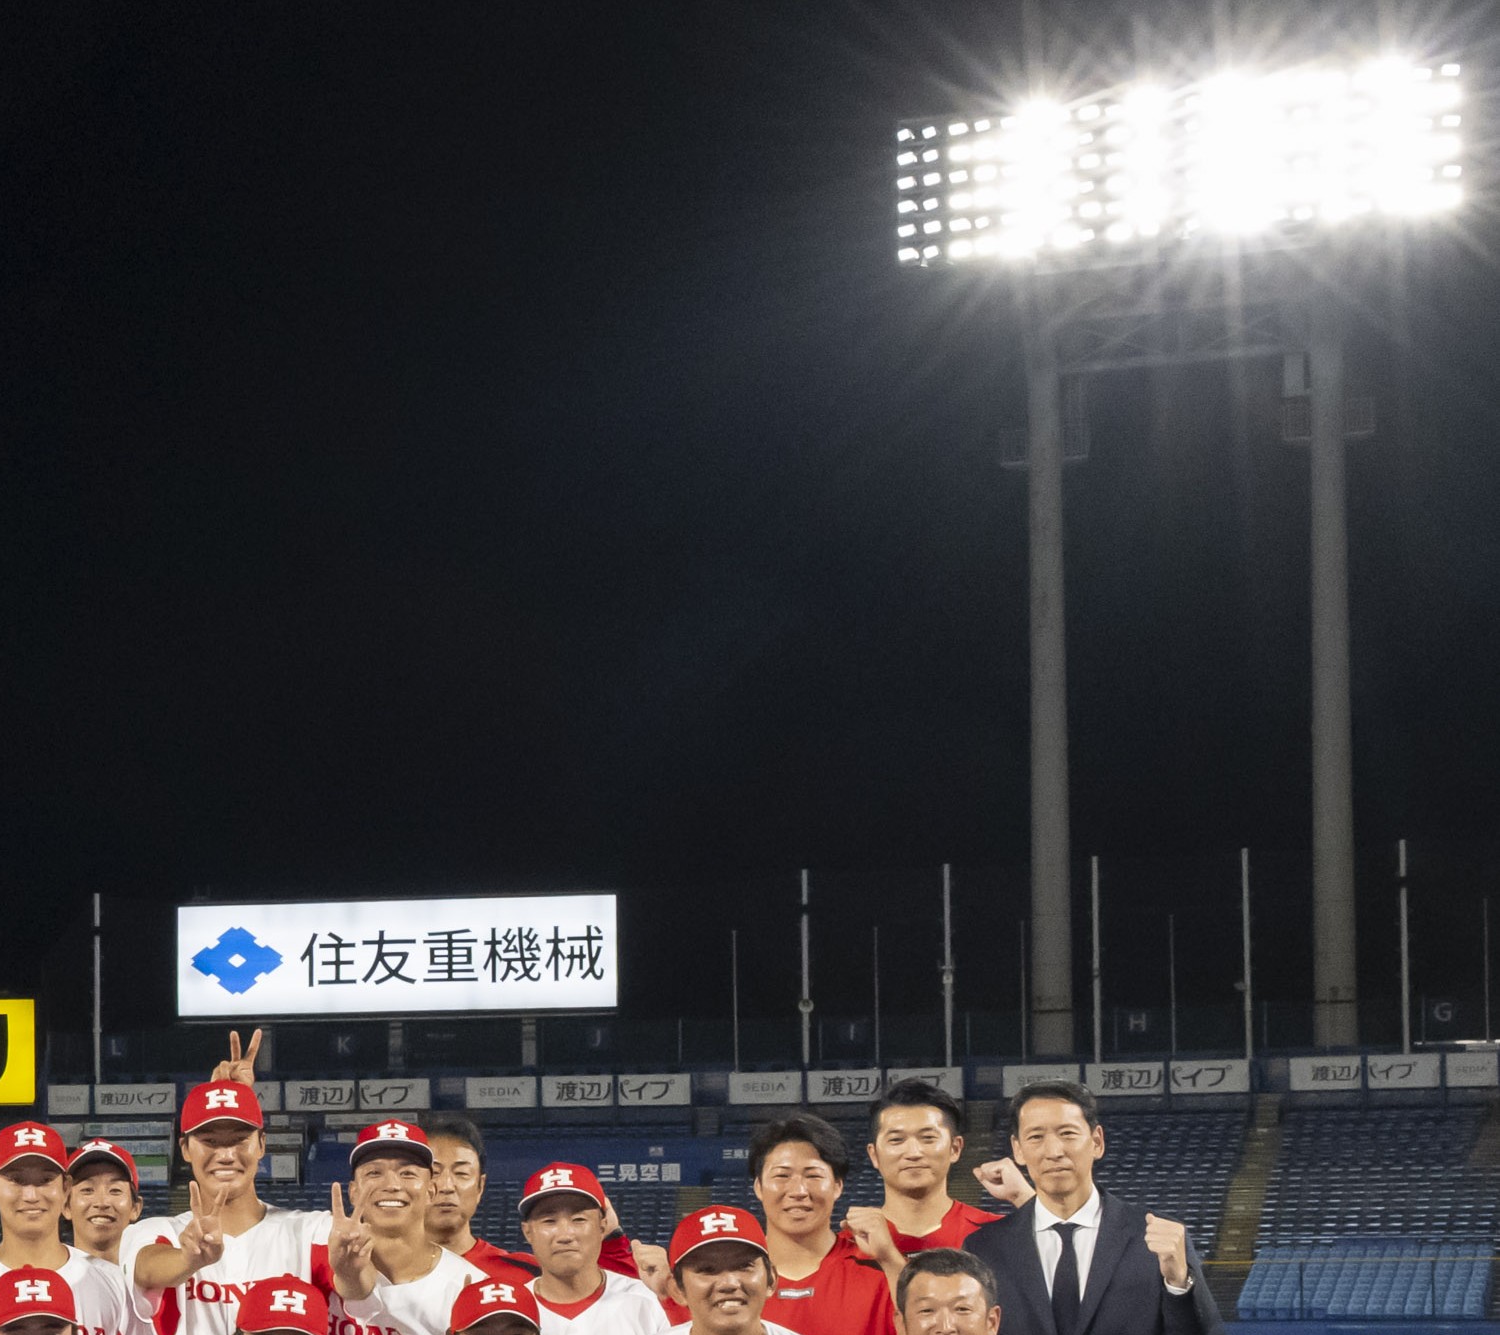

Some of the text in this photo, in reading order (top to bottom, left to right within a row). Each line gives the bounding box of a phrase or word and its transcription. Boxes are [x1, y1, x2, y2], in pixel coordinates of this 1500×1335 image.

[300, 923, 605, 988] 住友重機械
[555, 1076, 675, 1101] 渡辺パイプ
[1101, 1063, 1232, 1090] 渡辺パイプ
[299, 1083, 415, 1106] 渡辺パイプ
[597, 1163, 681, 1182] 三晃空調
